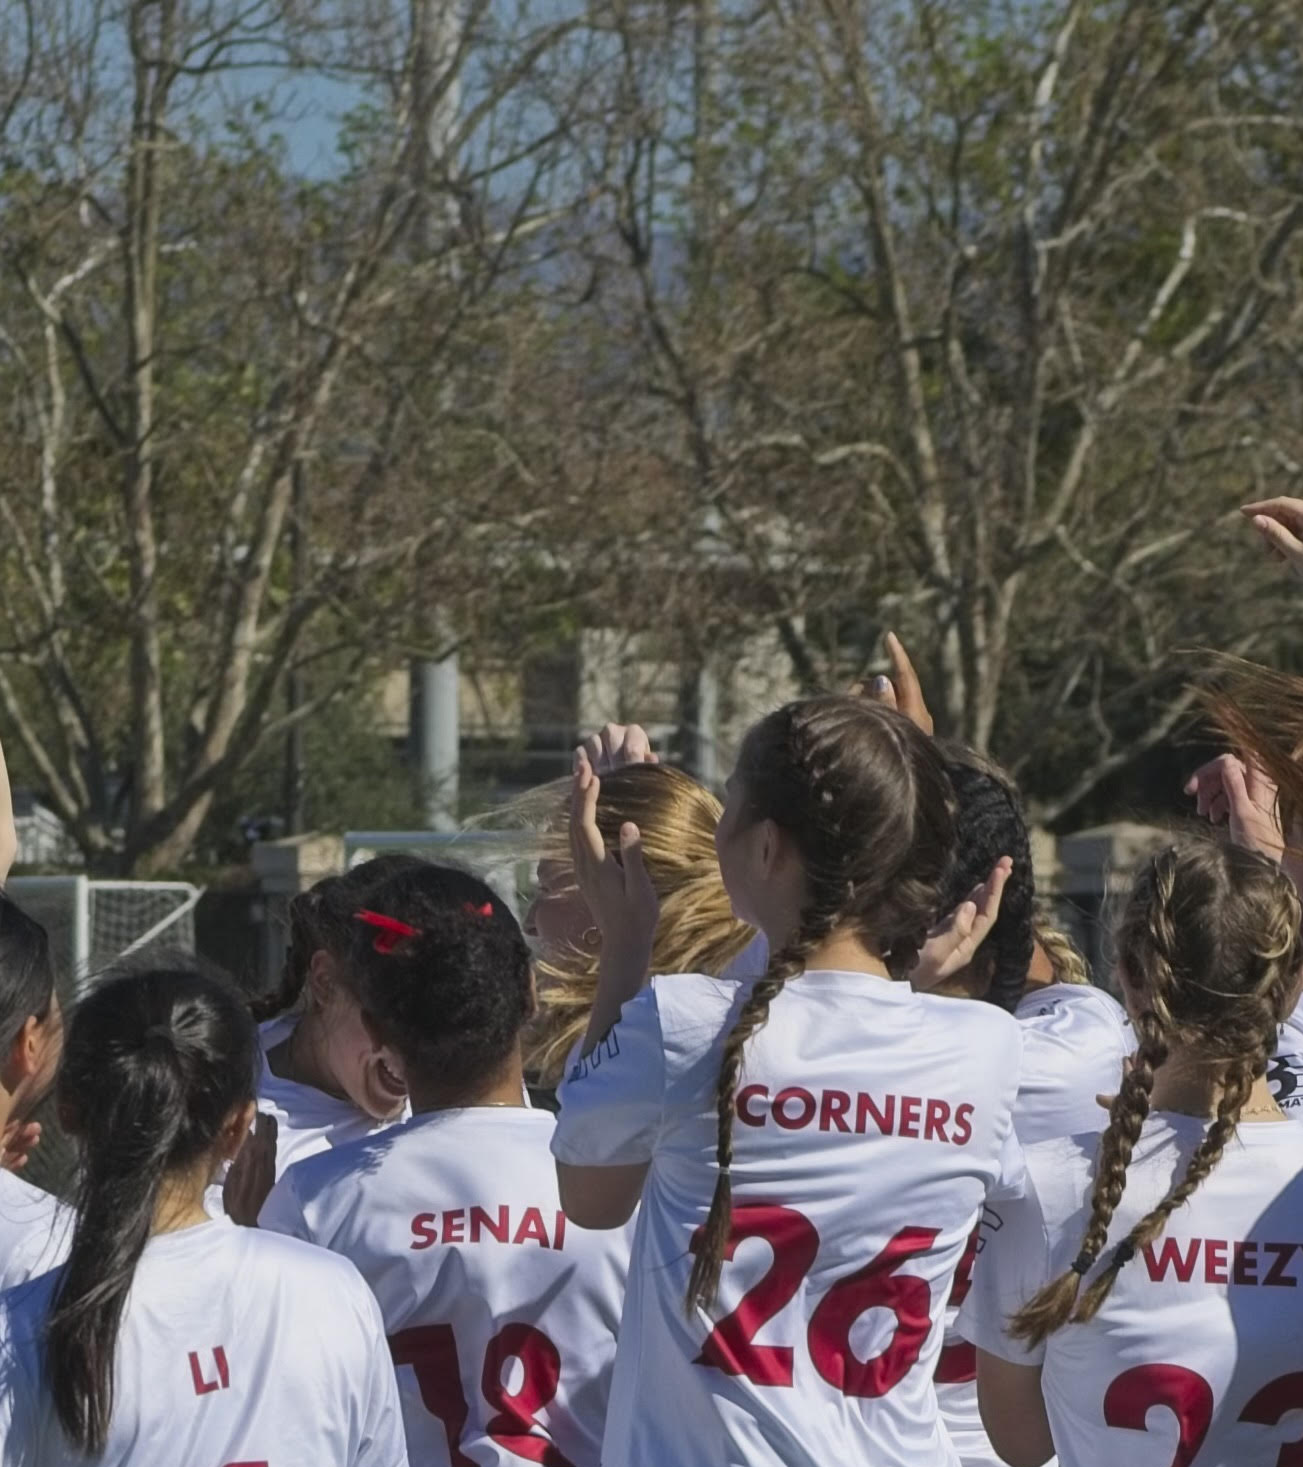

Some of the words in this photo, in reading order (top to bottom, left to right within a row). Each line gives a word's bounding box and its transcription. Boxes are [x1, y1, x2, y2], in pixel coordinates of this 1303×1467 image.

[737, 1083, 976, 1147] CORNERS
[409, 1204, 567, 1251] SENAI
[688, 1201, 942, 1399] 26
[189, 1345, 229, 1396] LI
